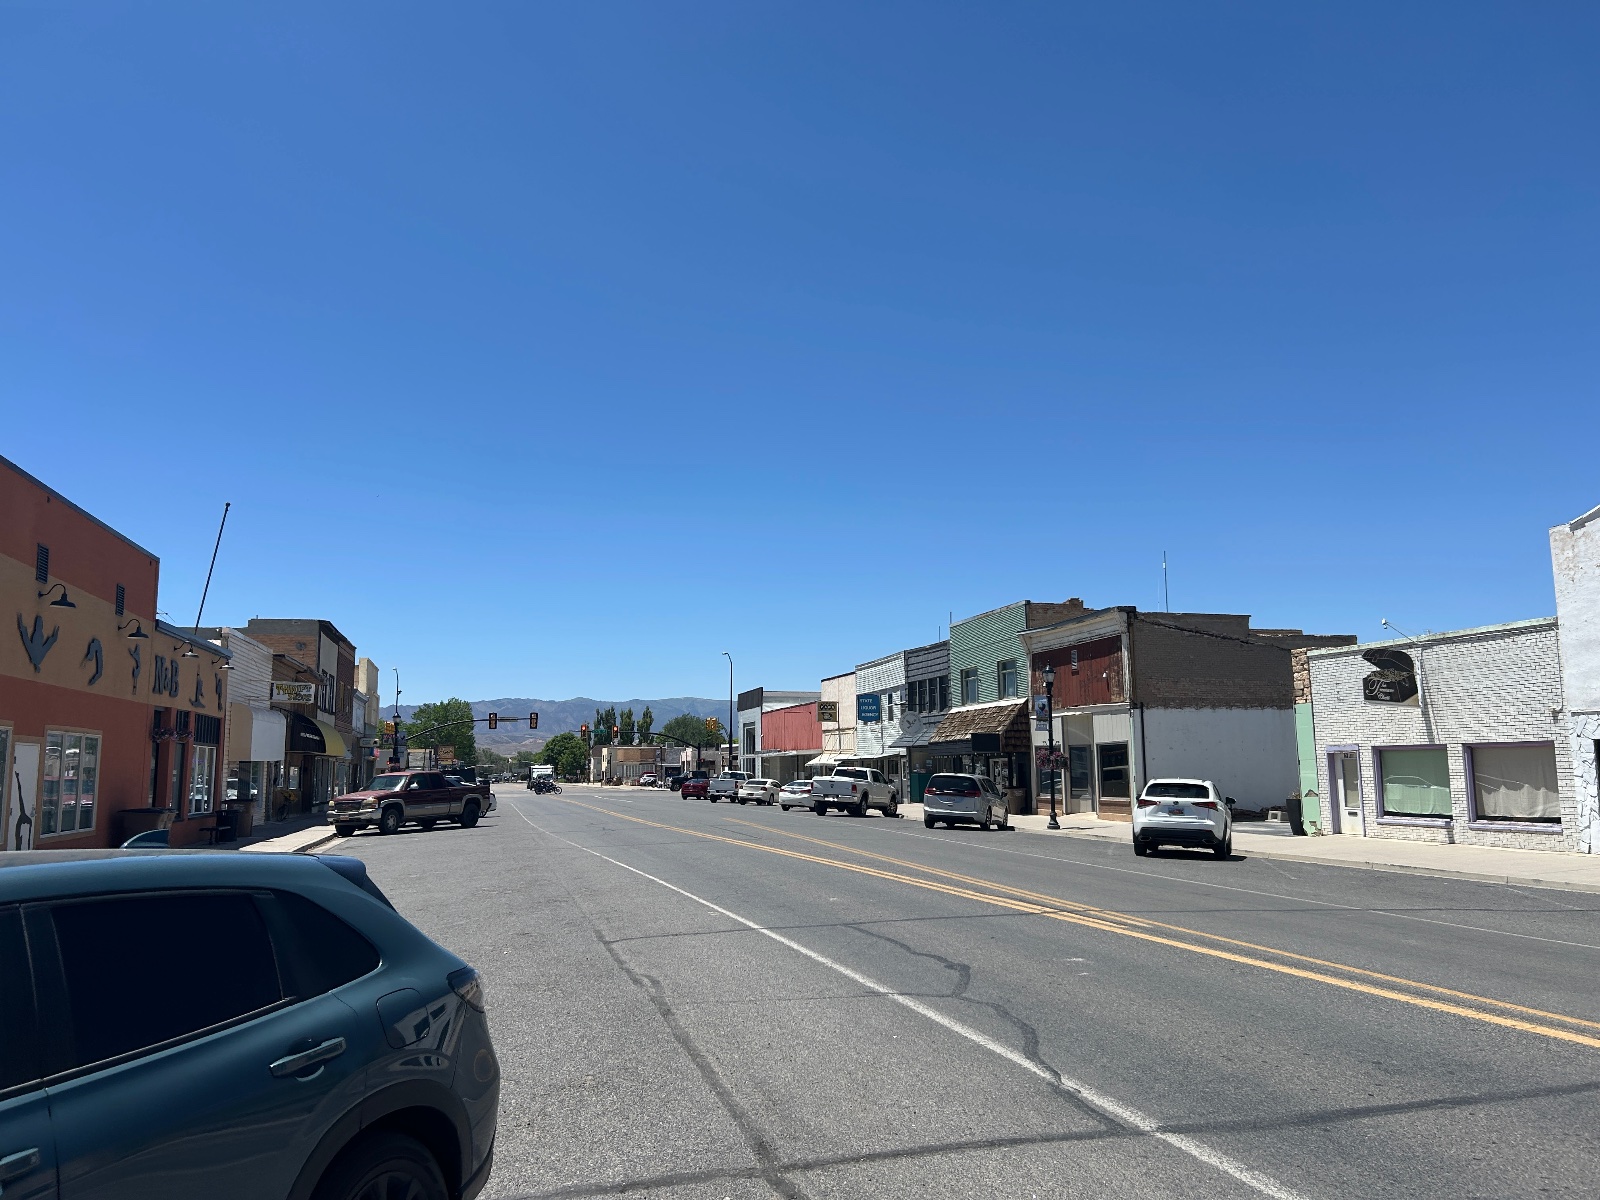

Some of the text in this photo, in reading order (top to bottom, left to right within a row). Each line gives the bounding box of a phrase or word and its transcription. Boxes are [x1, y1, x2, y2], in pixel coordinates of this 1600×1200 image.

[153, 655, 179, 697] N&B
[276, 684, 312, 695] THRIFT
[287, 693, 312, 702] STORE
